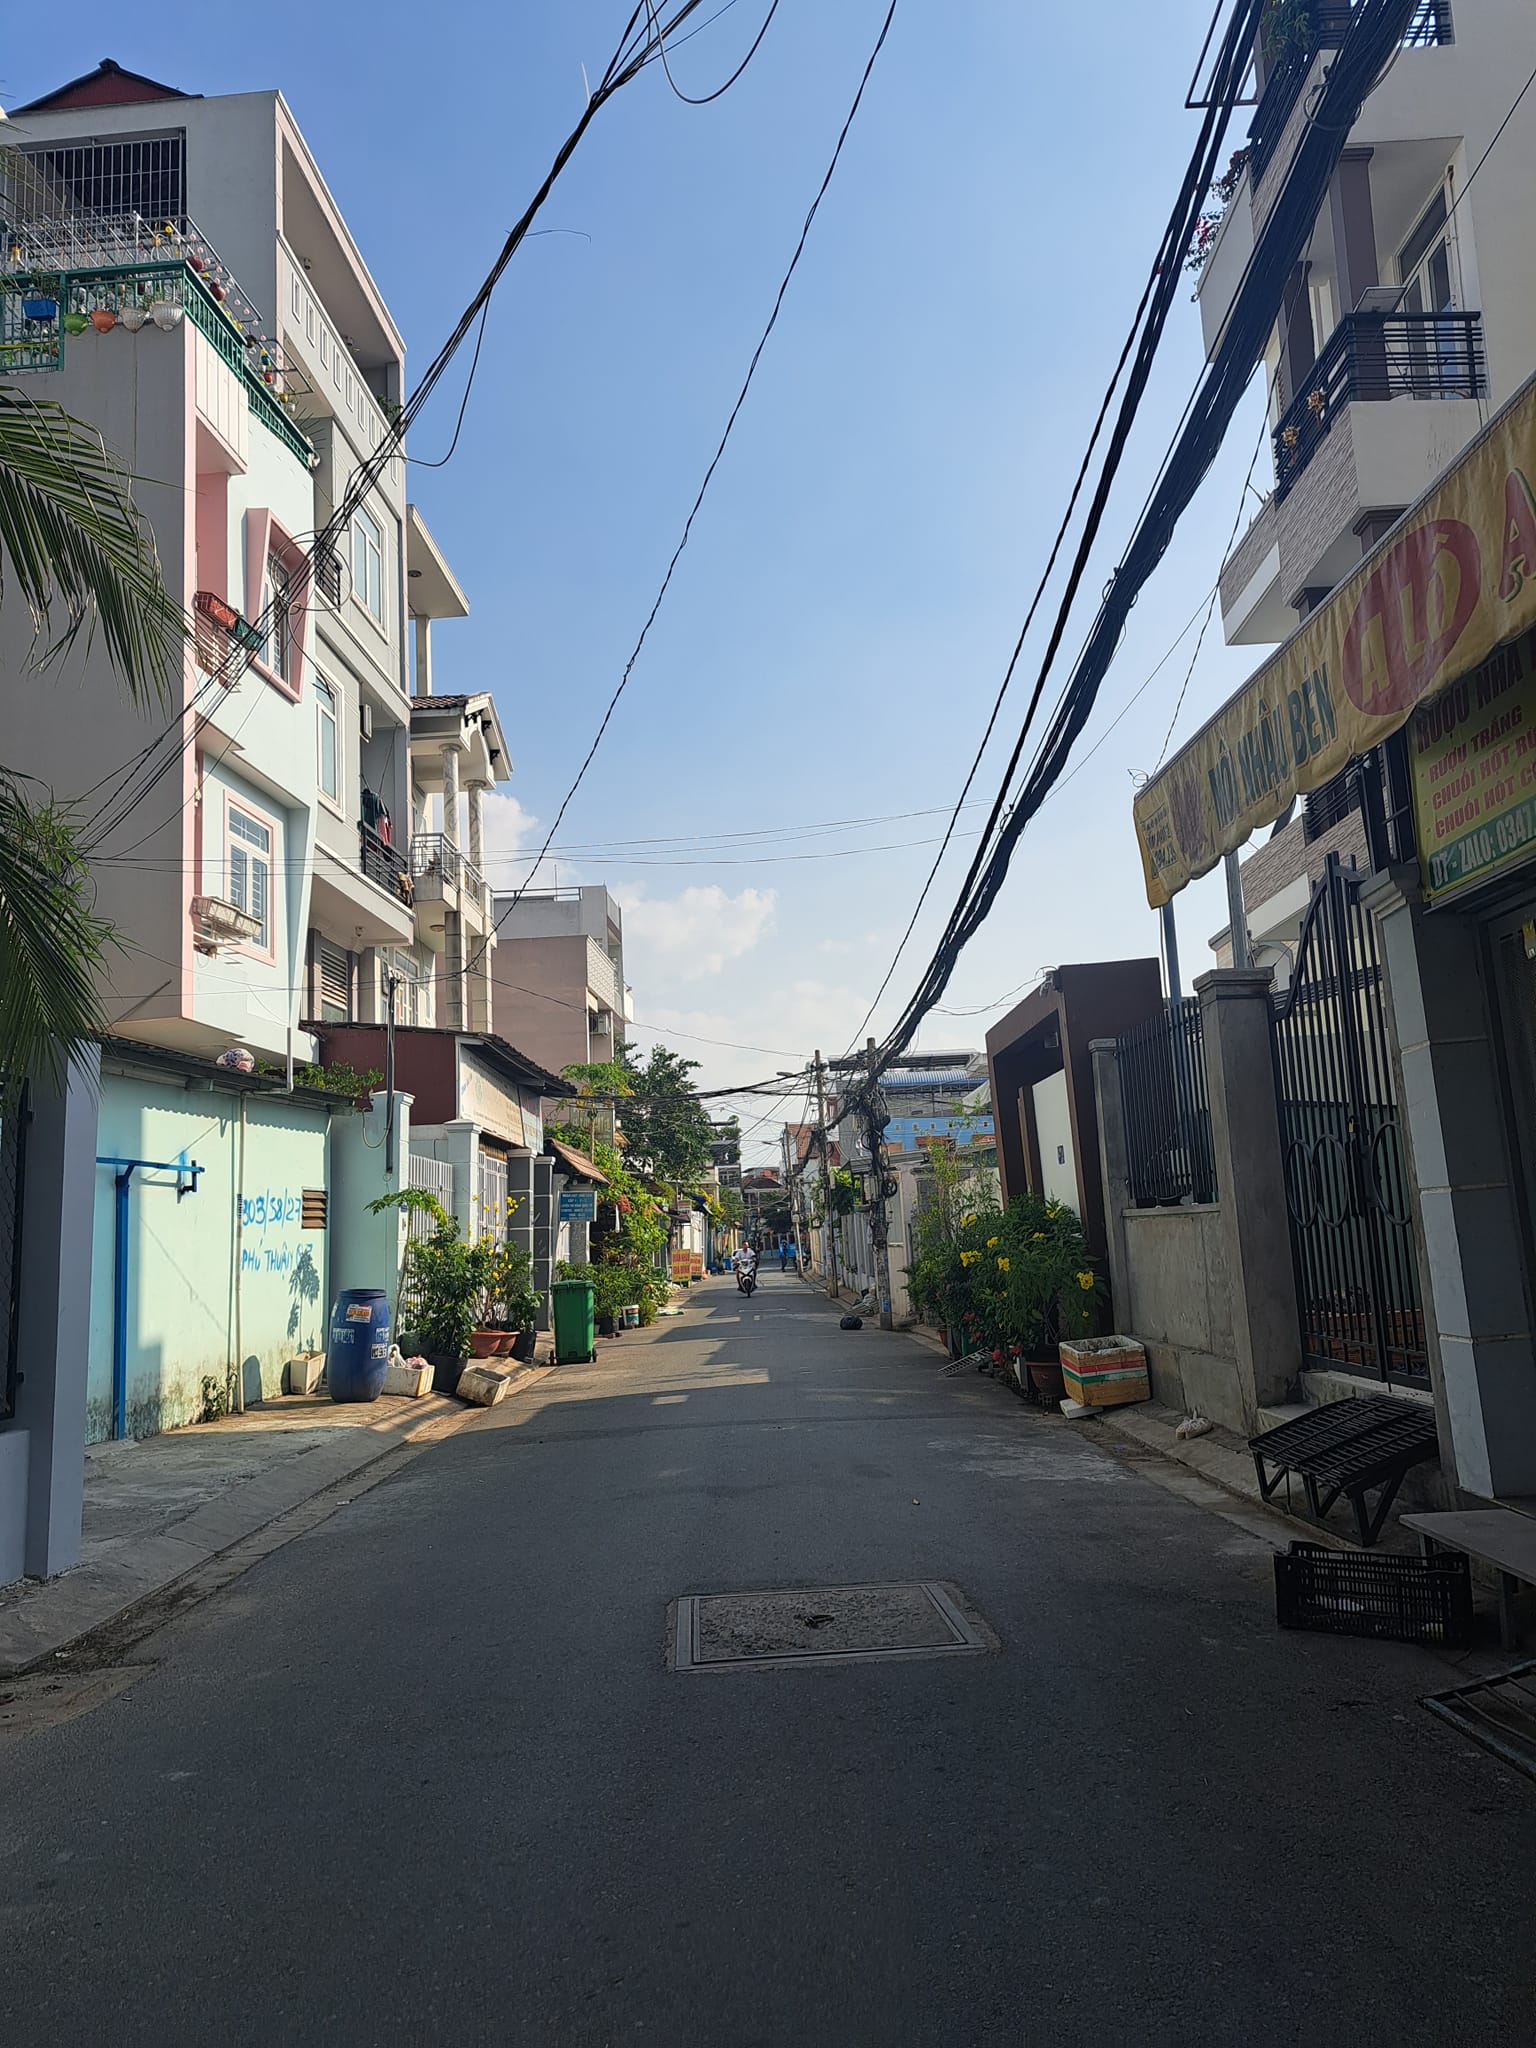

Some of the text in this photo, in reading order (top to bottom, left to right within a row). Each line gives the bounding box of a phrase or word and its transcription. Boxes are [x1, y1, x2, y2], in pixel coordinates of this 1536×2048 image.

[1237, 698, 1289, 807] NHẬU
[1287, 655, 1336, 769] BÉN
[1429, 743, 1467, 783] RƯỢU
[1432, 768, 1476, 810] CHUỐI
[1479, 745, 1510, 780] HỘT
[1484, 776, 1514, 810] HỘT
